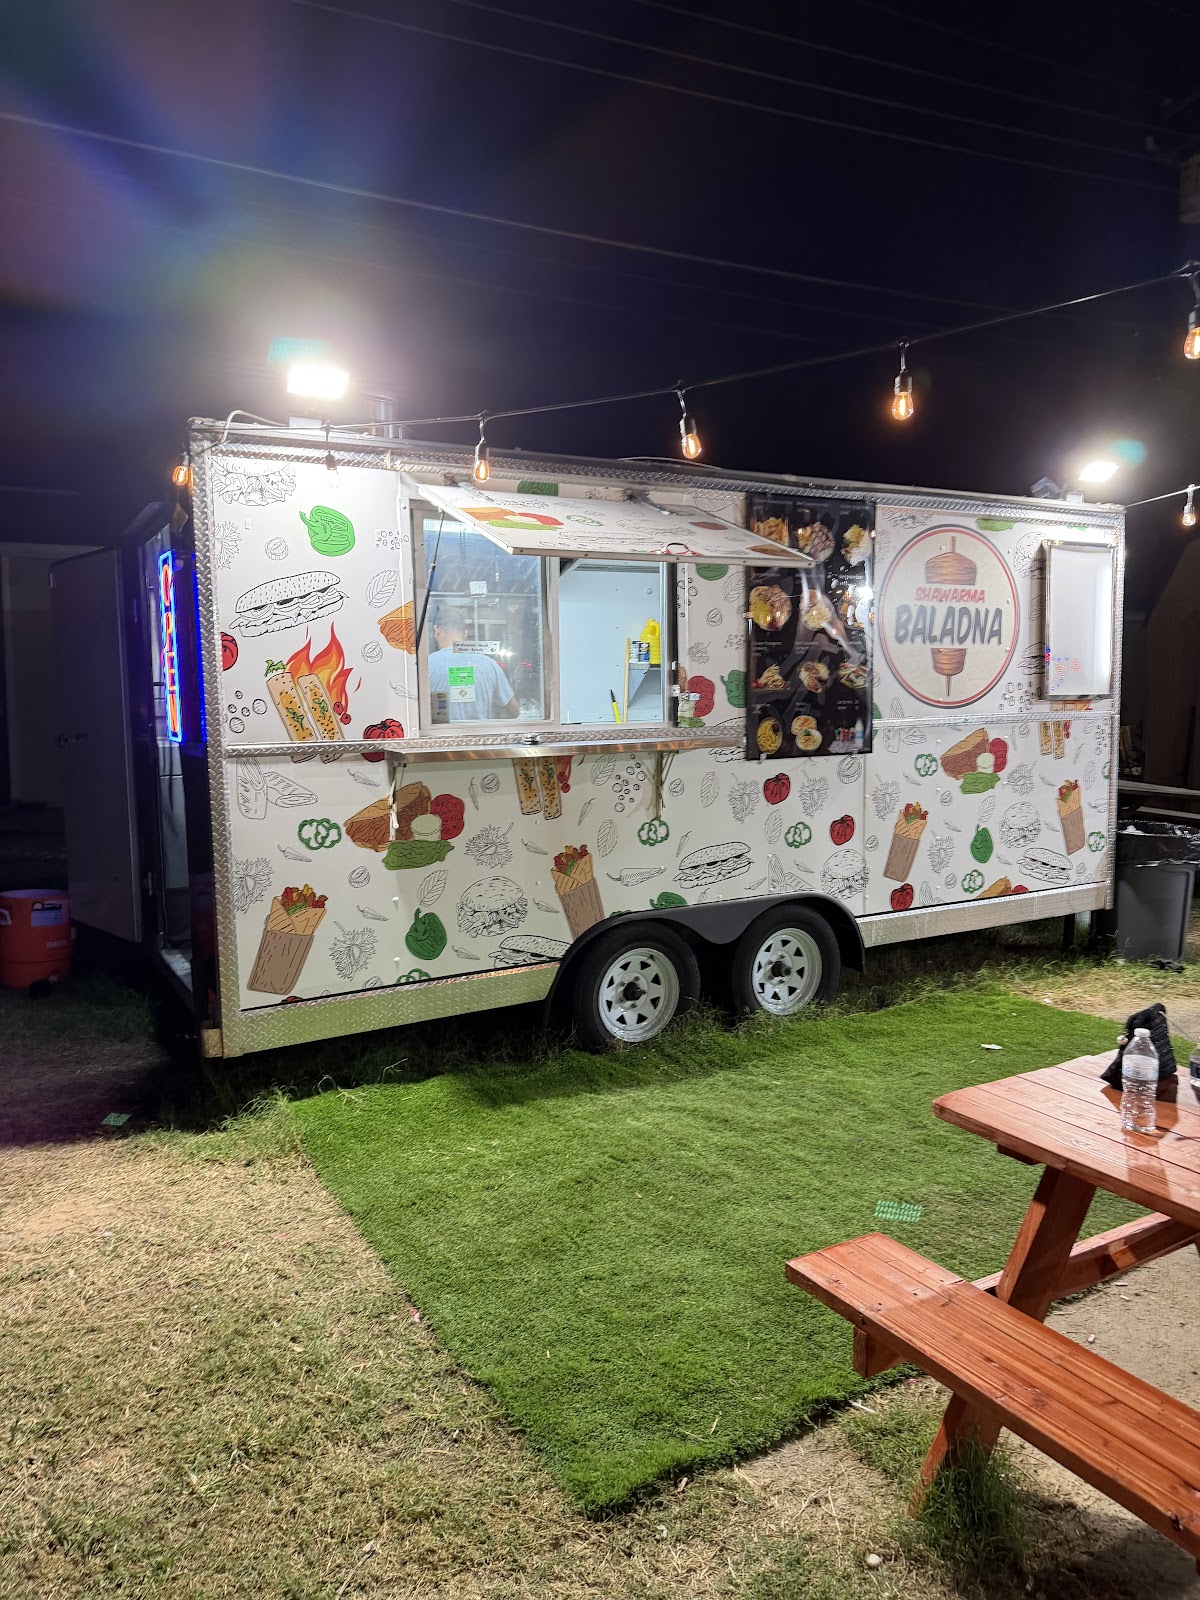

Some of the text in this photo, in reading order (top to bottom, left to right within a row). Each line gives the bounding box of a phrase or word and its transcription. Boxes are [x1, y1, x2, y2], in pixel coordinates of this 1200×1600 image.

[914, 586, 986, 603] SHAWARMA
[894, 604, 1003, 645] BALADNA
[162, 564, 179, 732] OPEN
